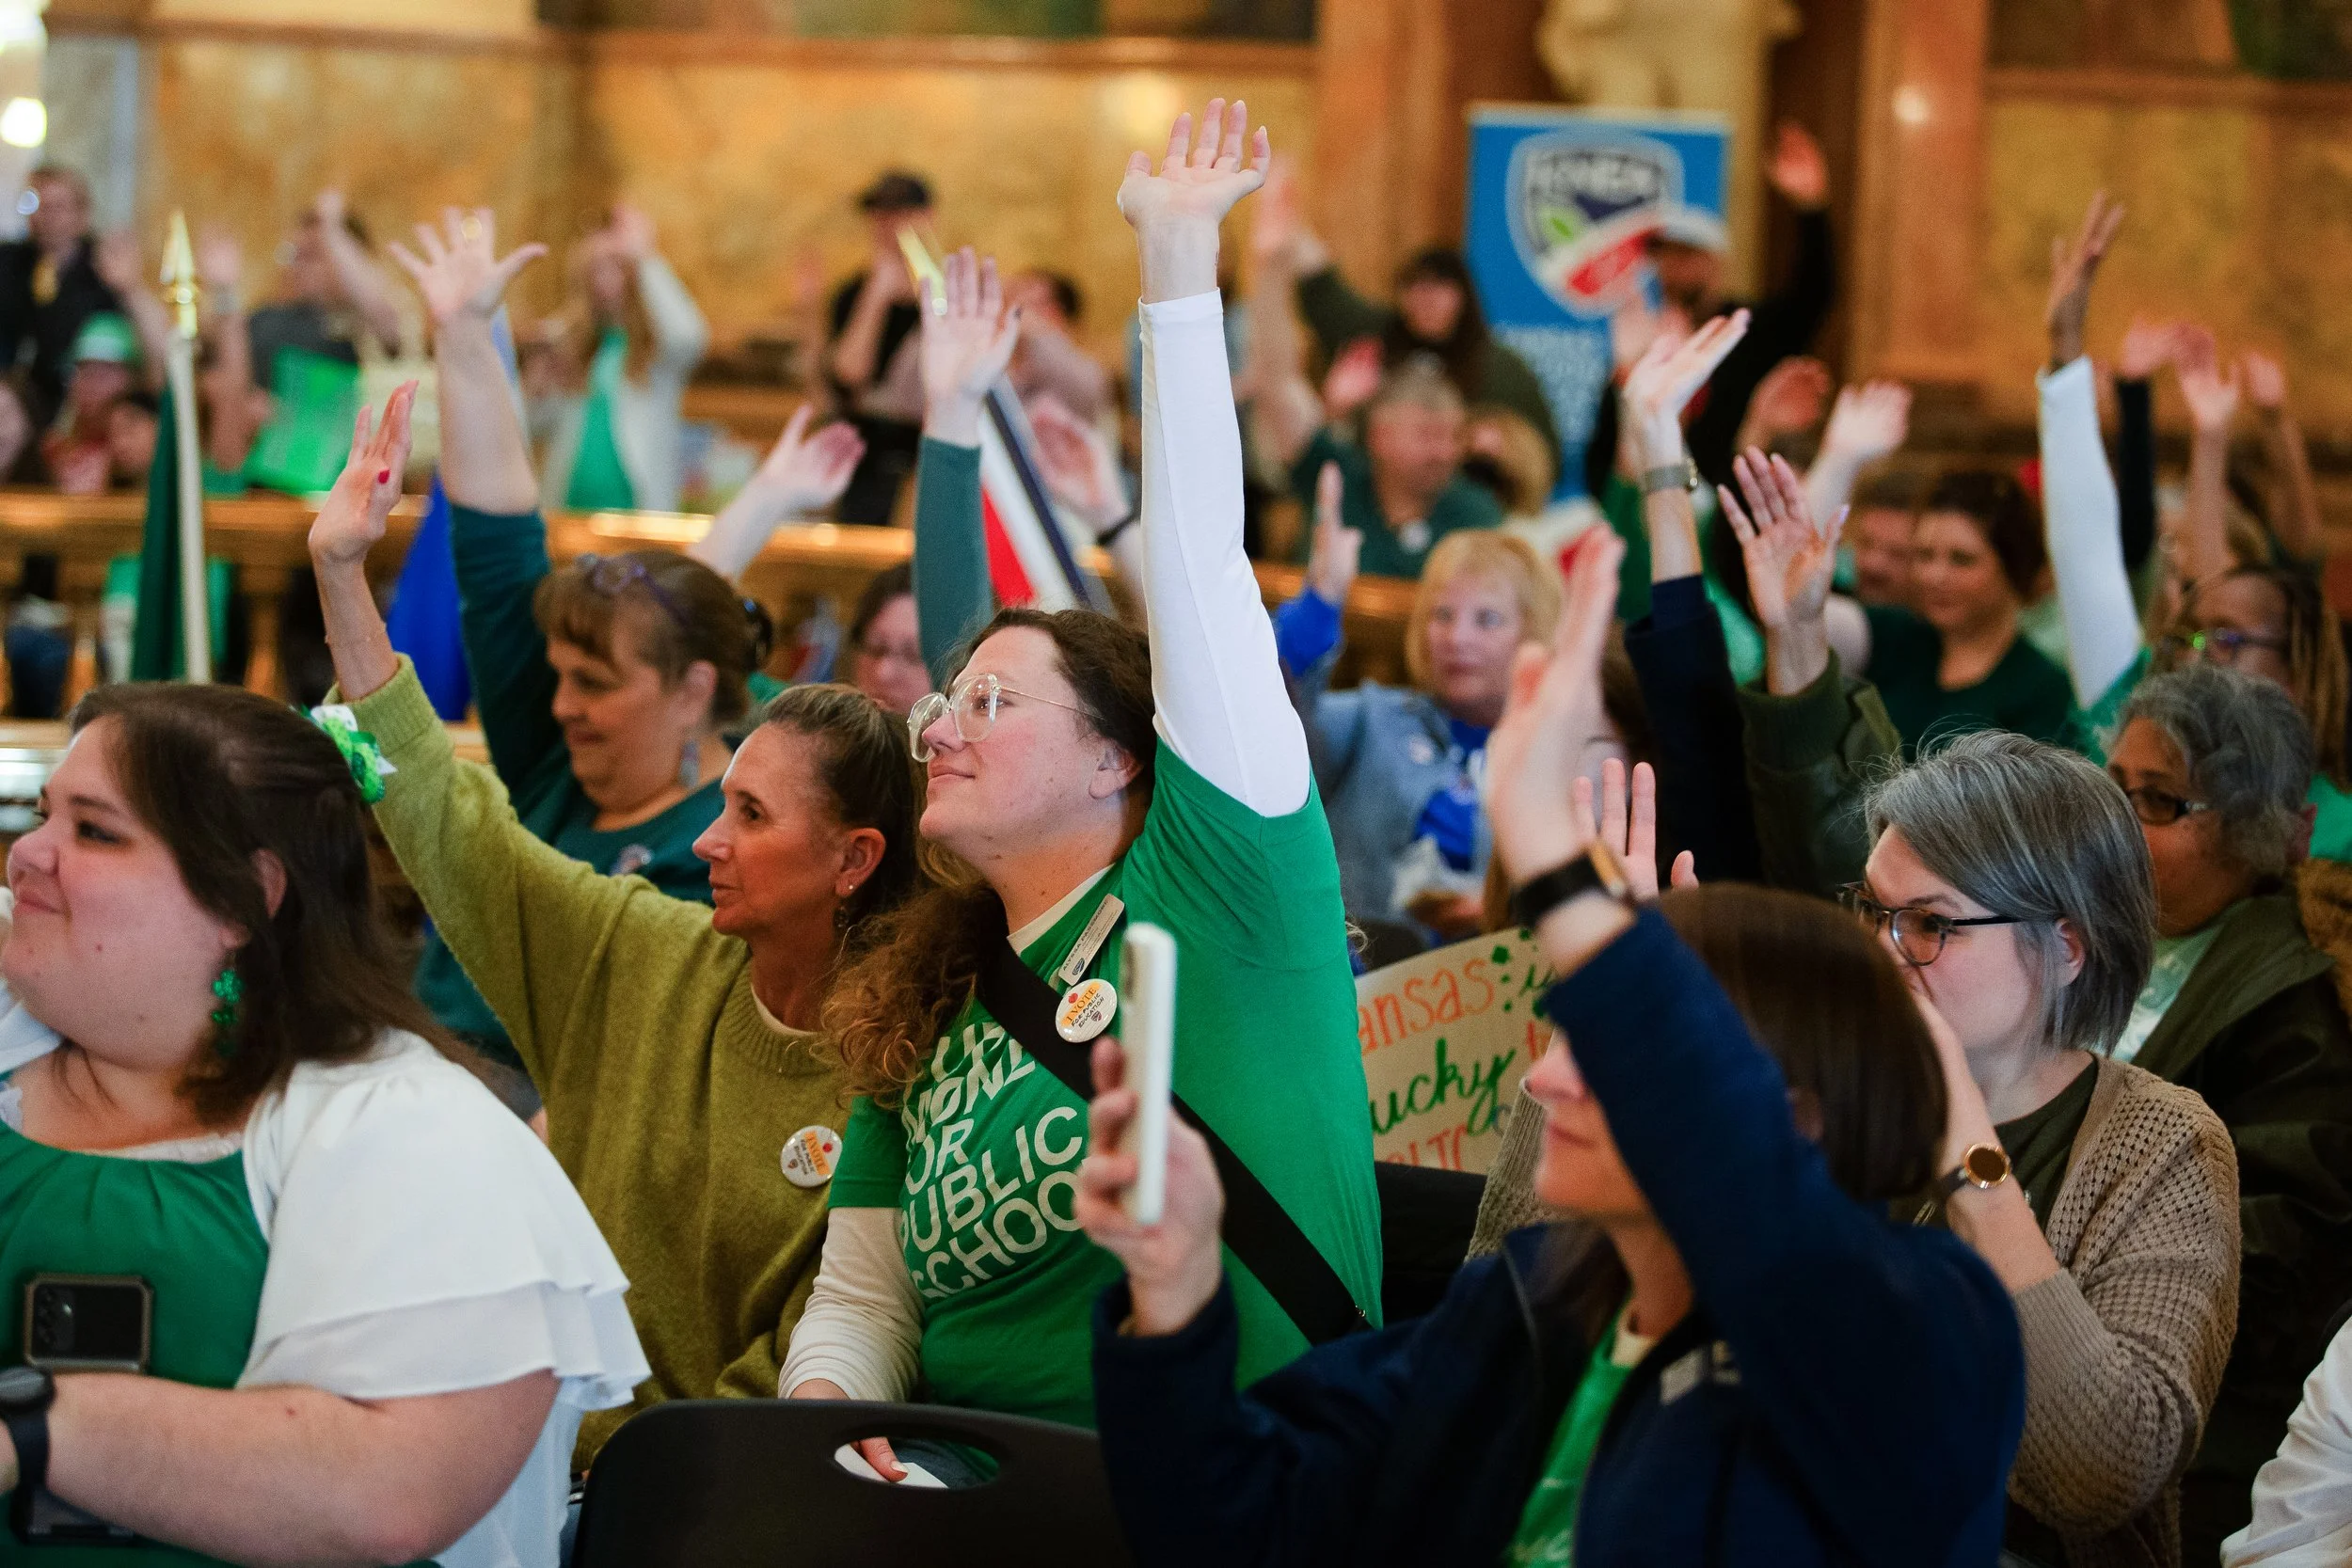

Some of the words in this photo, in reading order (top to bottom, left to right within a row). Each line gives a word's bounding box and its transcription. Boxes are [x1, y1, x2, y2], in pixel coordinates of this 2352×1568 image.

[1071, 988, 1097, 1015] VOTE
[1071, 1014, 1084, 1027] FOR
[1082, 993, 1101, 1014] PUBLIC
[1078, 996, 1104, 1028] EDUCATION
[1358, 958, 1496, 1056] ansas
[1369, 1037, 1517, 1137] ucky
[905, 1117, 975, 1196] OR
